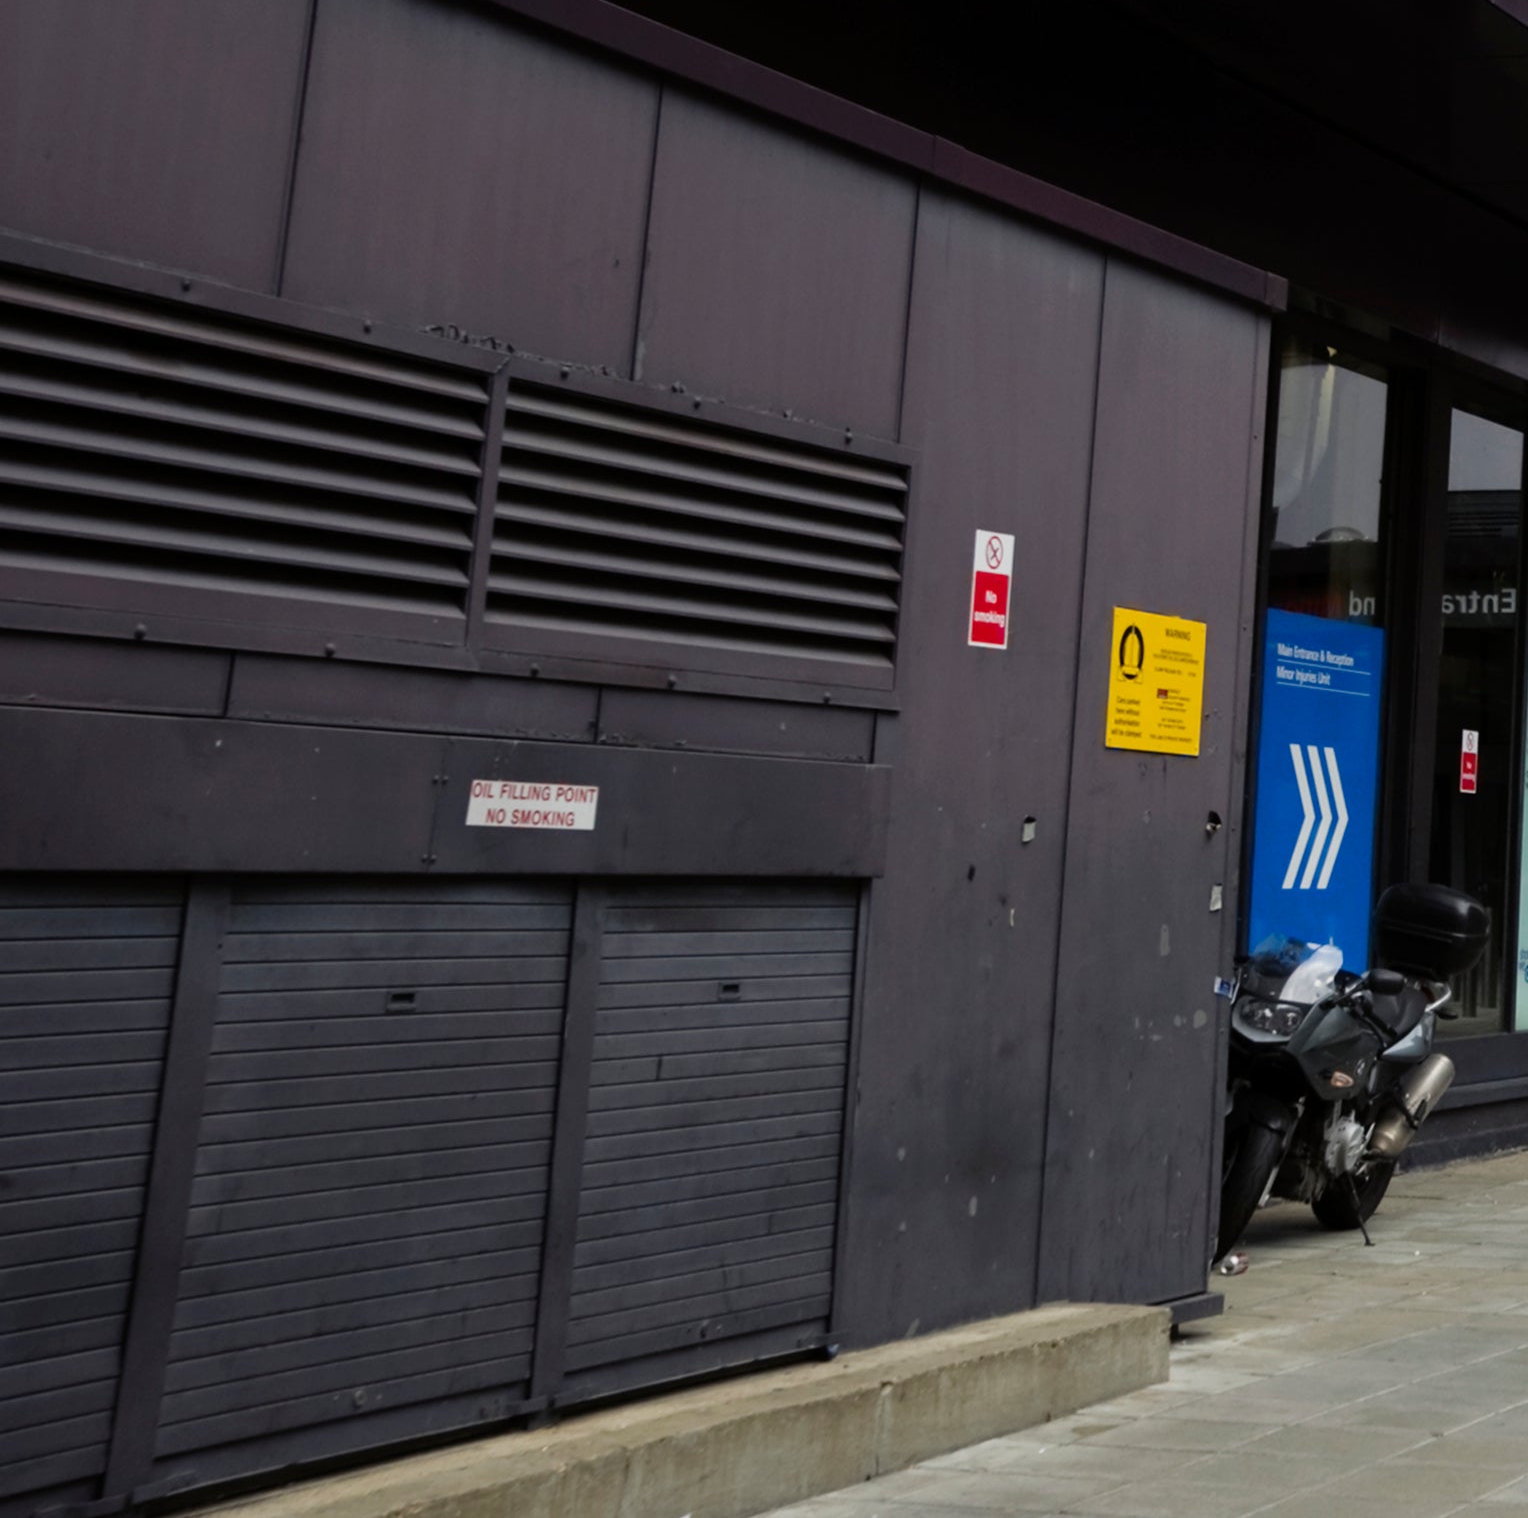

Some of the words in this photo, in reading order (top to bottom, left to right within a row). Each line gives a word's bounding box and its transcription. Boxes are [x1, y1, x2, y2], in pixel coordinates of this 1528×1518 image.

[985, 590, 998, 604] No
[974, 611, 1005, 628] smoking
[1277, 643, 1293, 658] Main
[1294, 645, 1319, 661] Entrance
[1326, 651, 1354, 667] Reception
[1276, 665, 1295, 681] Minor
[472, 782, 494, 798] OIL
[500, 784, 551, 801] FILLING
[555, 787, 597, 803] POINT
[485, 808, 506, 824] NO
[511, 809, 576, 826] SMOKING
